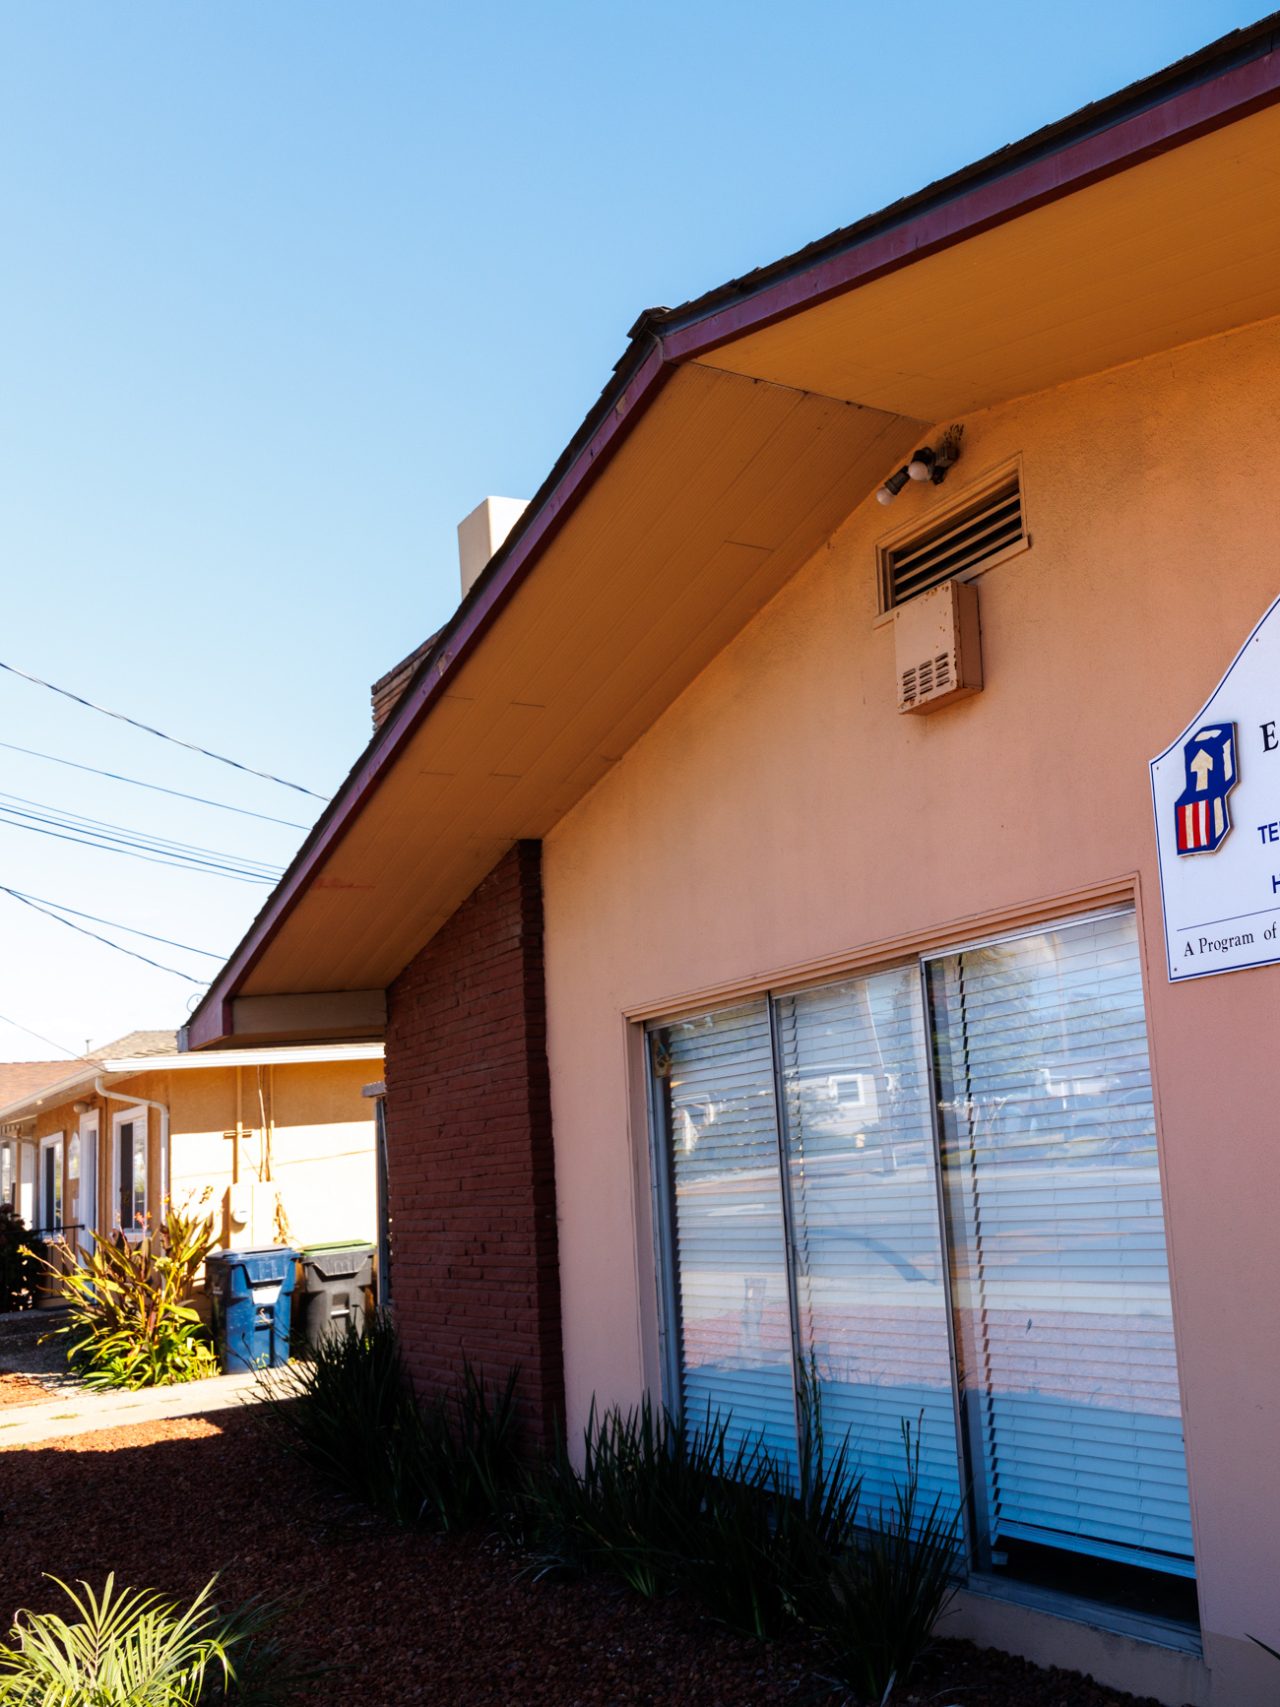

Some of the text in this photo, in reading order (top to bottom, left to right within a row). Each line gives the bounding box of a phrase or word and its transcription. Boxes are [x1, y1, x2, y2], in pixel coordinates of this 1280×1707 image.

[1184, 942, 1194, 957] A
[1199, 933, 1254, 953] Program
[1264, 922, 1276, 940] of
